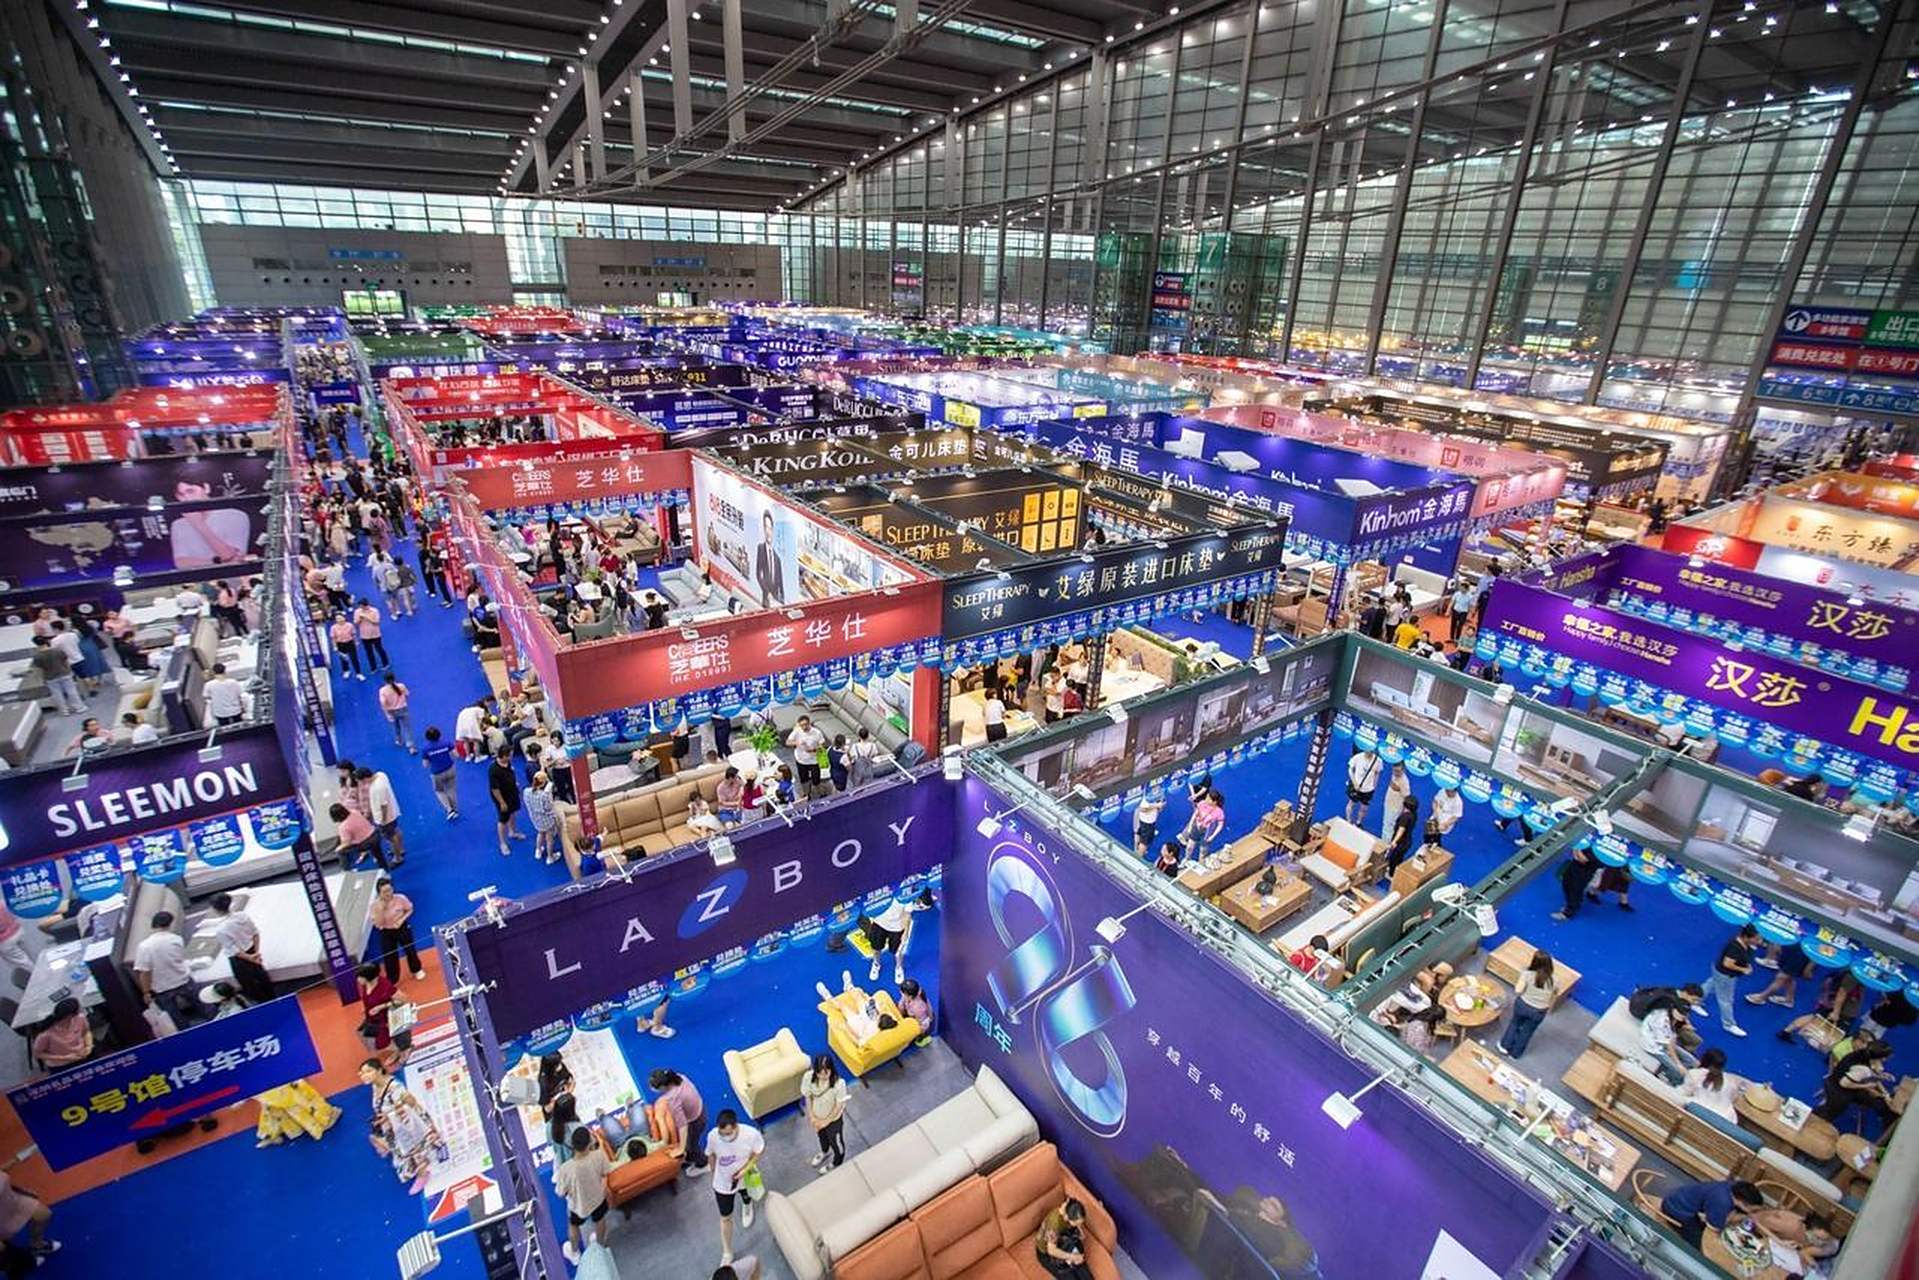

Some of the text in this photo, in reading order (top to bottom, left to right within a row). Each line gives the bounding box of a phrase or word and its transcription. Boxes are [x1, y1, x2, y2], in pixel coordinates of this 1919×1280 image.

[1207, 241, 1218, 262] 7
[1596, 276, 1607, 290] 8
[888, 441, 970, 461] 金可儿床垫
[575, 465, 645, 488] 芝华仕
[1360, 505, 1422, 535] Kinhom
[1055, 547, 1214, 601] 艾绿原装进口床垫
[952, 582, 1032, 610] SLEEPTHERAPY
[767, 611, 867, 658] 芝华仕
[1806, 600, 1896, 640] 汉莎
[1705, 655, 1808, 707] 汉莎
[46, 761, 259, 839] SLEEMON
[10, 868, 50, 885] 礼品卡
[974, 1000, 1013, 1055] 周年
[61, 1033, 283, 1128] 9号馆停车场
